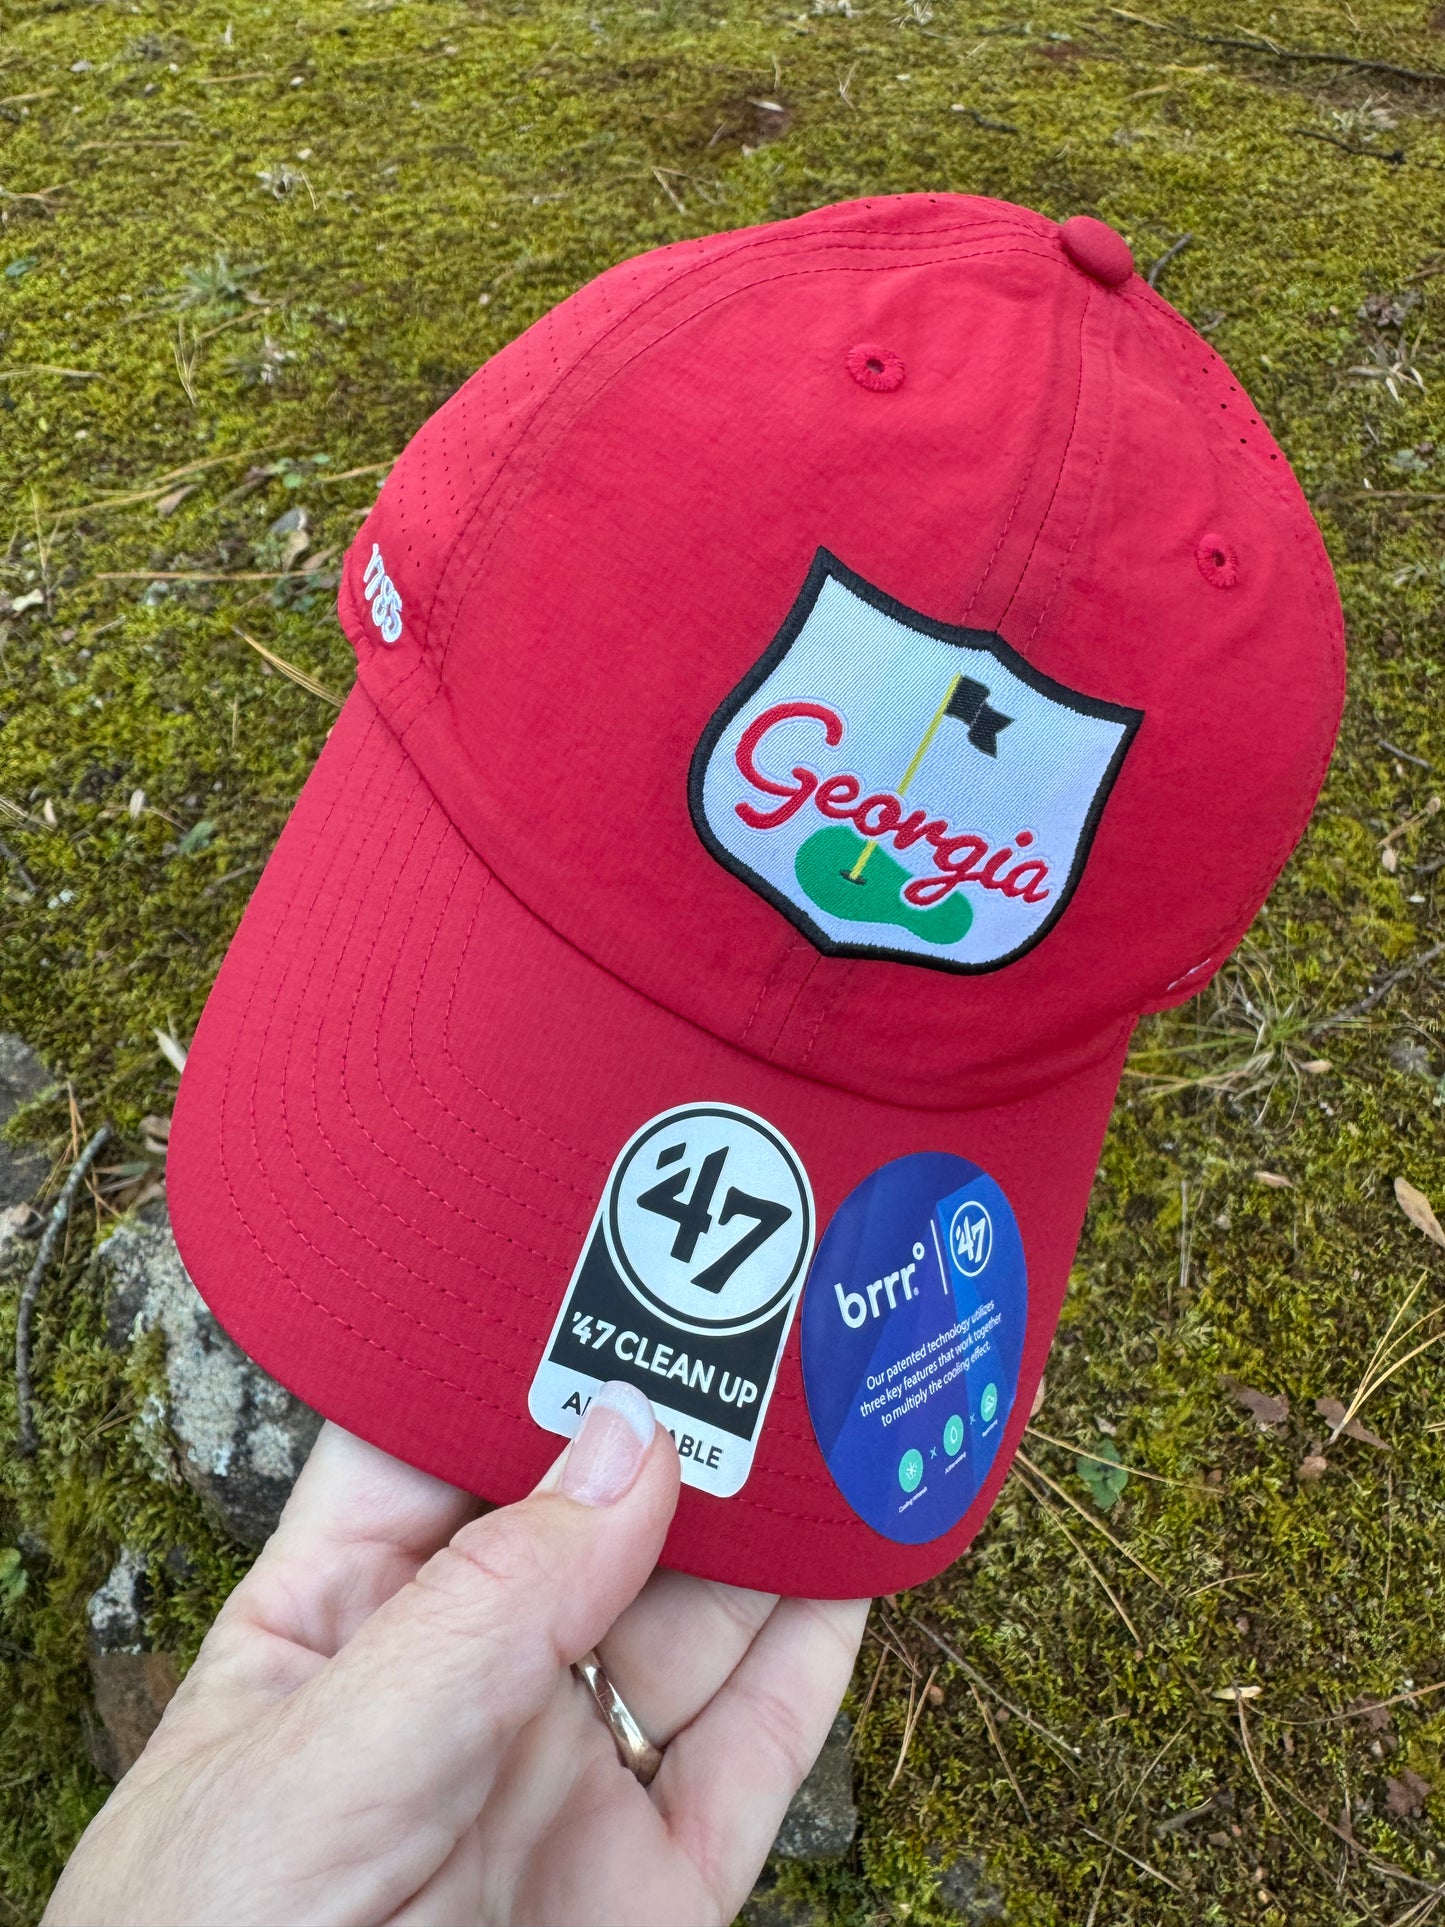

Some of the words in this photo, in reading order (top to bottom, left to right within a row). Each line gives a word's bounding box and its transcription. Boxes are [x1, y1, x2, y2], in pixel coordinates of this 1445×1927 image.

[735, 702, 1050, 906] Georgia
[572, 1311, 616, 1350] '47
[614, 1331, 715, 1394] CLEAN
[718, 1371, 758, 1408] UP
[860, 1394, 886, 1417] three
[886, 1384, 902, 1402] key
[903, 1361, 938, 1391] features
[938, 1348, 954, 1367] that
[954, 1333, 974, 1355] work
[973, 1312, 1001, 1341] together
[866, 1372, 885, 1390] Our
[886, 1343, 927, 1382] patented
[927, 1317, 970, 1353] technology
[881, 1415, 893, 1427] to
[892, 1388, 928, 1420] multiply
[928, 1380, 943, 1395] the
[943, 1358, 970, 1384] cooling
